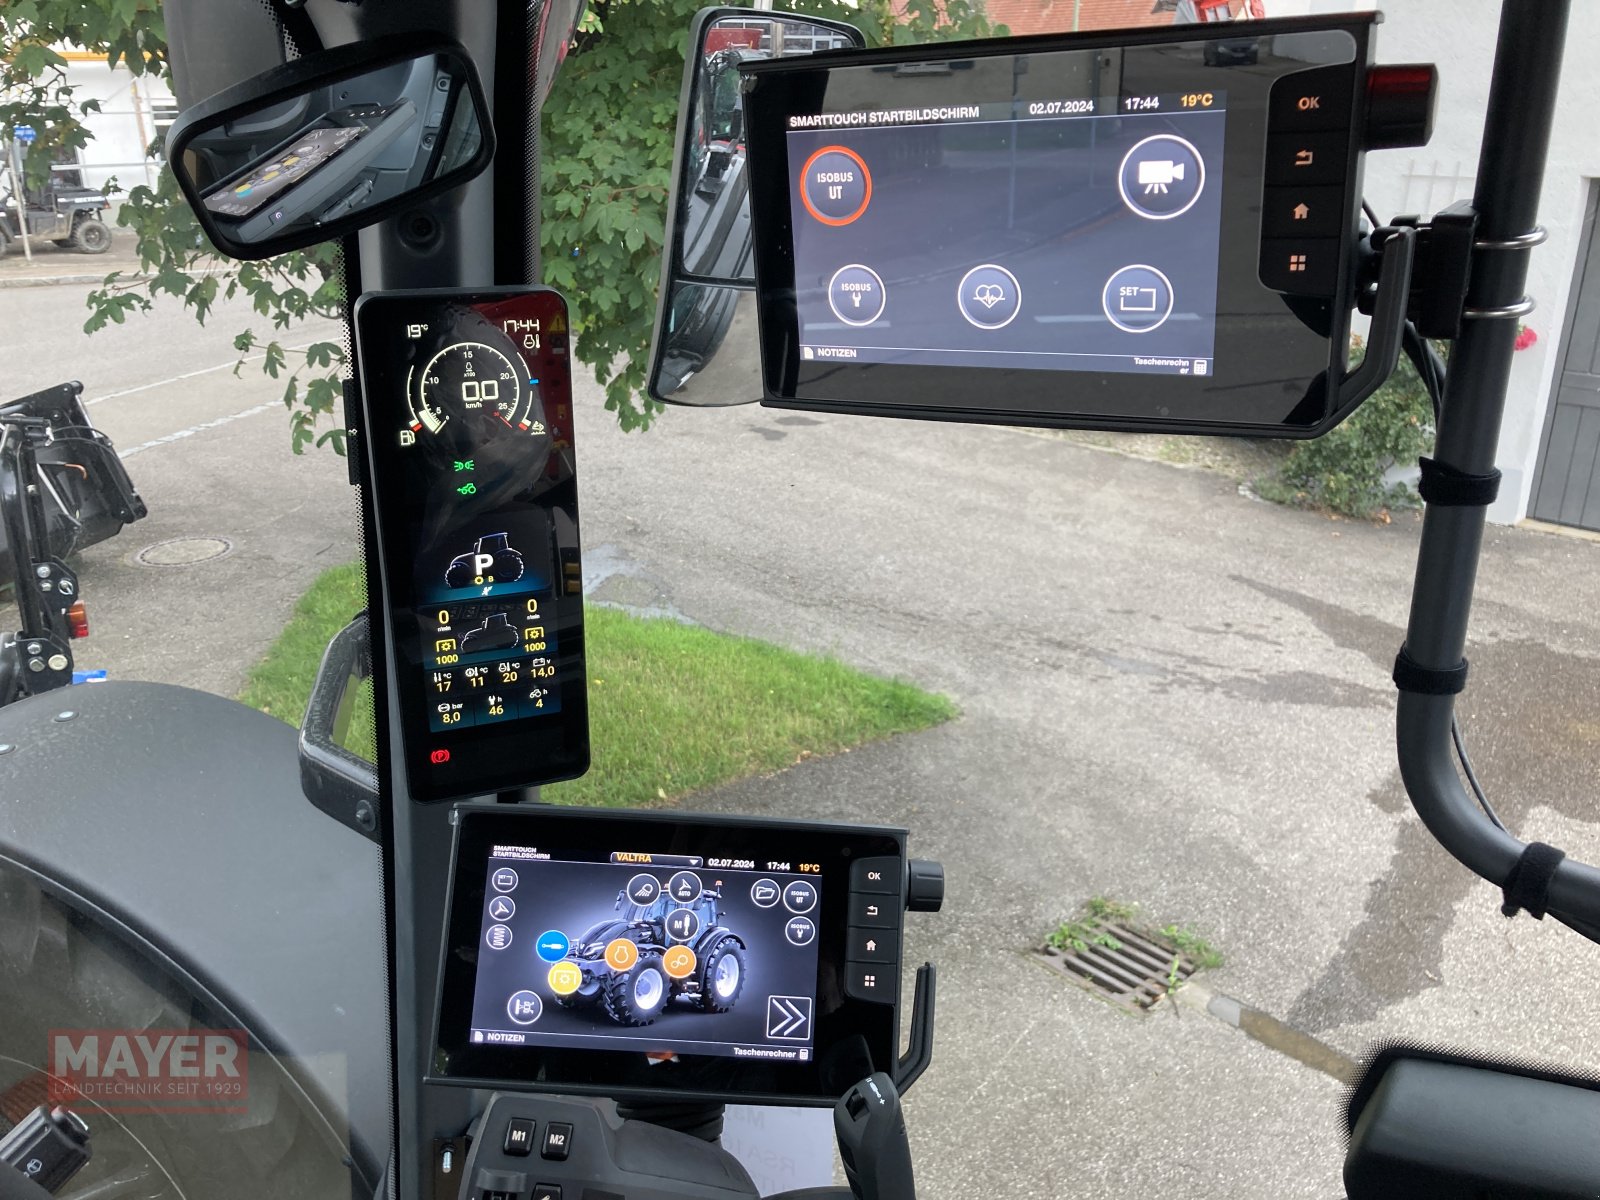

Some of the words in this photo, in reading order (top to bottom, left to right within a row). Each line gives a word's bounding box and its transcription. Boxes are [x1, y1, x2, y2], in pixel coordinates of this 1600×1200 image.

[1125, 96, 1160, 110] 17:44
[1180, 93, 1213, 107] 19°C
[1297, 96, 1320, 111] OK
[1029, 100, 1095, 115] 02.07.2024
[789, 112, 867, 128] SMARTTOUCH
[869, 106, 980, 124] STARTBILDSCHIRM
[817, 172, 853, 183] ISOBUS
[828, 186, 842, 199] UT
[841, 283, 872, 292] ISOBUS
[1119, 286, 1139, 296] SET
[503, 319, 540, 333] 17:44
[817, 347, 857, 358] NOTIZEN
[1134, 357, 1189, 367] Taschenrechn
[429, 377, 440, 385] 10
[436, 406, 442, 415] 5
[498, 402, 508, 410] 25
[526, 598, 538, 613] 0
[438, 610, 450, 625] 0
[524, 641, 546, 652] 1000
[435, 654, 459, 665] 1000
[502, 671, 518, 683] 20
[530, 665, 555, 679] 14,0
[436, 681, 452, 693] 17
[470, 676, 485, 687] 11
[535, 698, 543, 709] 4
[488, 704, 504, 716] 46
[442, 711, 461, 724] 8,0
[493, 845, 537, 853] SMARTTOUCH
[492, 850, 551, 860] STARTBILDSCHIRM
[616, 853, 652, 863] VALTRA
[708, 858, 755, 869] 02.07.2024
[767, 862, 791, 870] 17:44
[799, 864, 820, 872] 19°C
[868, 872, 881, 880] OK
[487, 1033, 526, 1043] NOTIZEN
[733, 1047, 797, 1058] Taschenrechner
[511, 1130, 526, 1141] M1
[549, 1134, 565, 1145] M2
